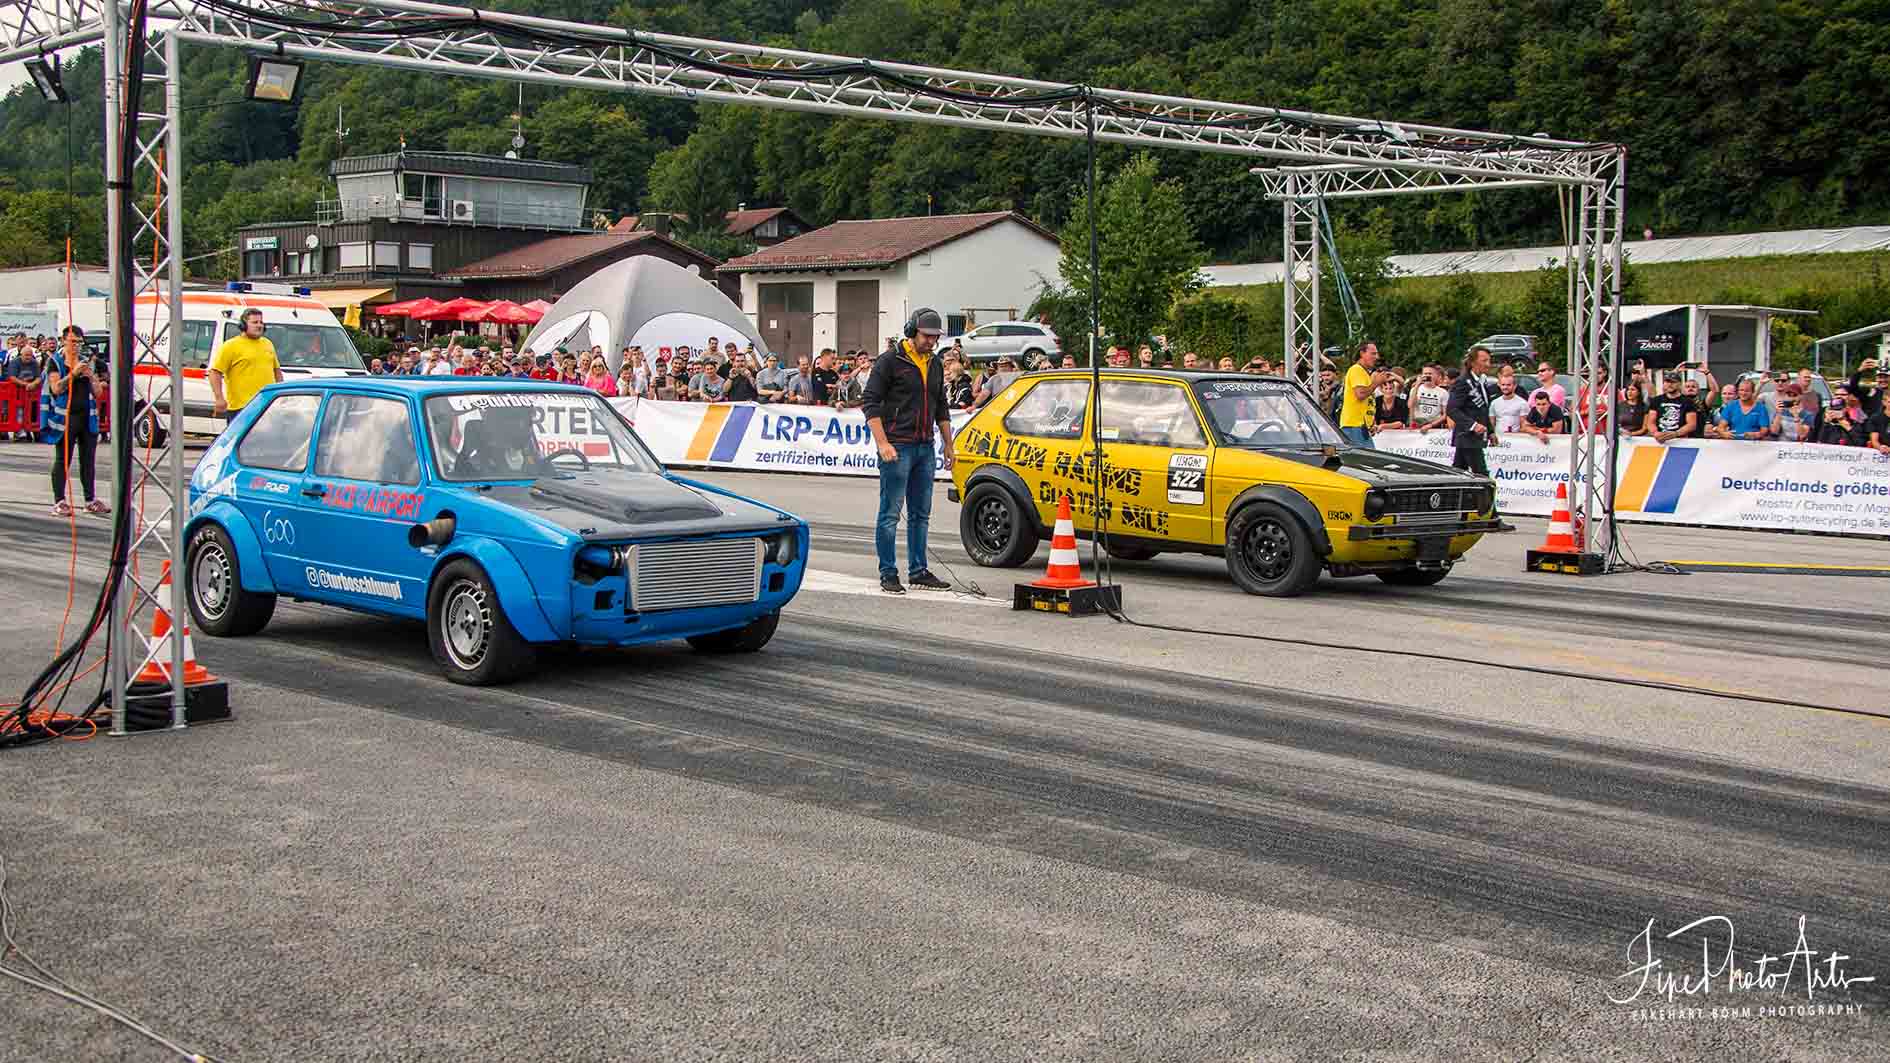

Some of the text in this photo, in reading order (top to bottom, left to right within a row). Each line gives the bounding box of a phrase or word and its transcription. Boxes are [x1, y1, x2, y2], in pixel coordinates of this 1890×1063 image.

[1640, 342, 1672, 350] ZANDER
[761, 414, 871, 445] LRP-Aut
[756, 450, 879, 468] zertifizierter Altfa
[1171, 470, 1202, 488] 522
[1721, 477, 1890, 498] Deutschlands größte
[1804, 500, 1853, 512] Chemnitz
[264, 510, 295, 544] 600
